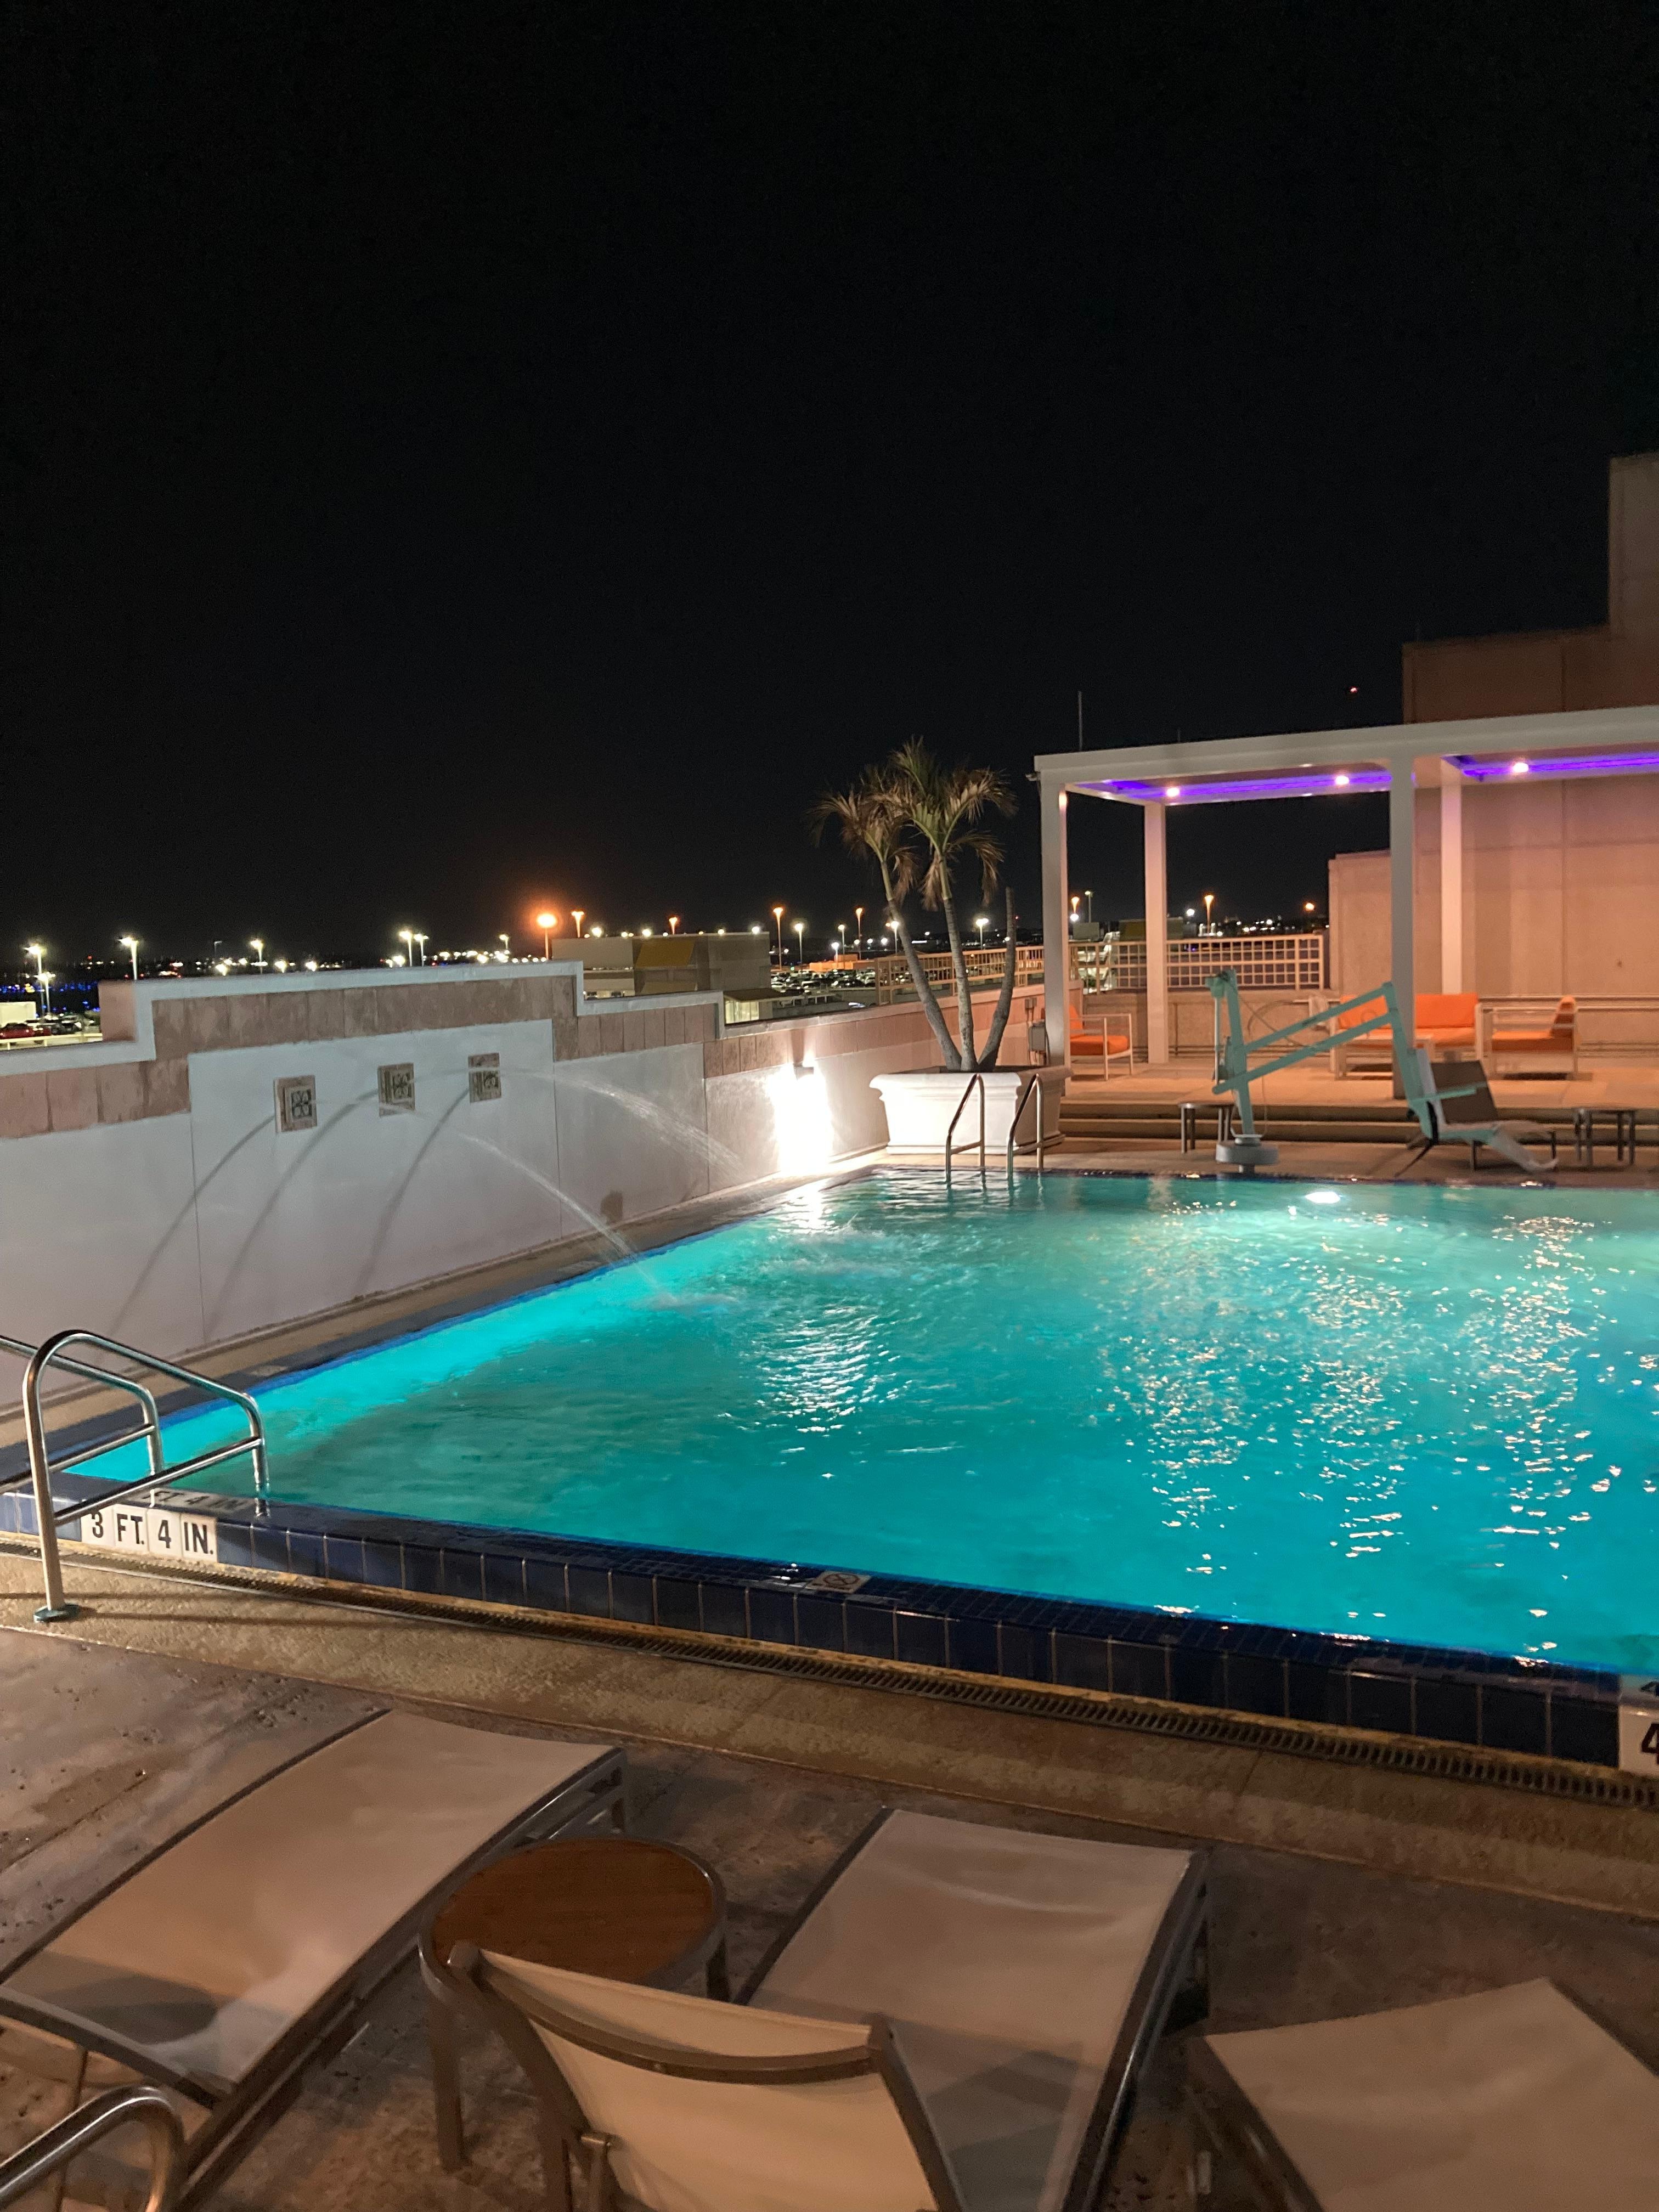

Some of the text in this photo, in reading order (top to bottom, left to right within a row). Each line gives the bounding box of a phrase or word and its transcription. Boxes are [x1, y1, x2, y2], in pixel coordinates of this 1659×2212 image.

[91, 1511, 213, 1555] 3 FT. 4 IN.
[1641, 1723, 1659, 1765] 4
